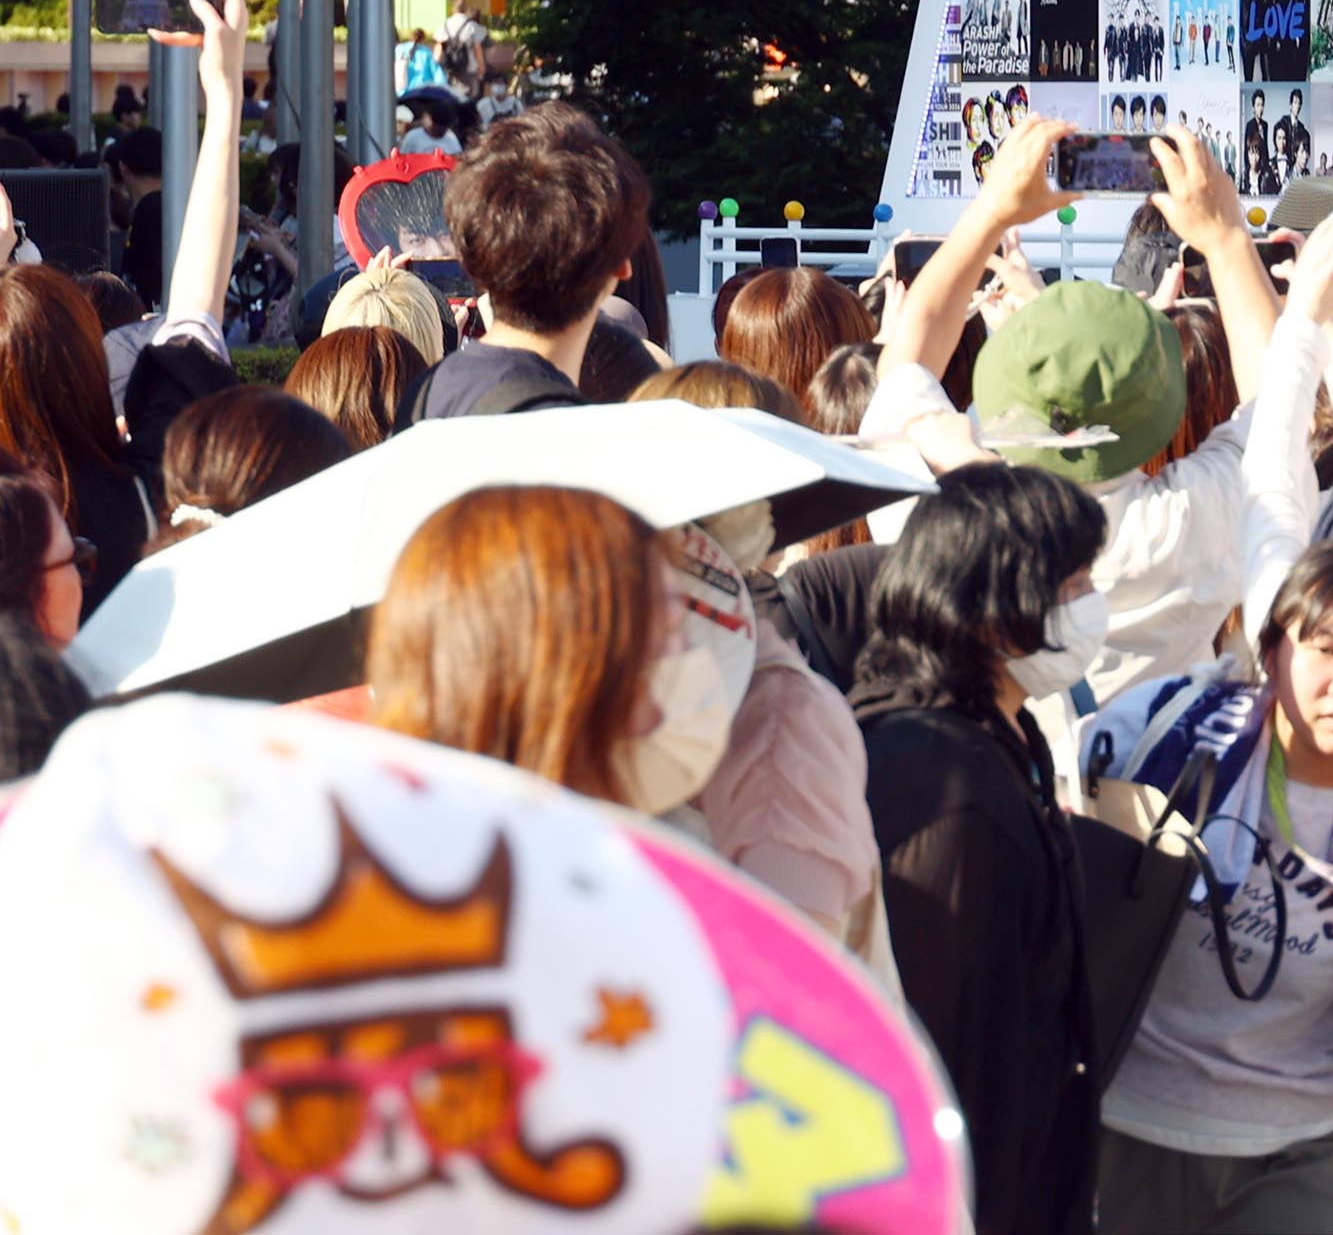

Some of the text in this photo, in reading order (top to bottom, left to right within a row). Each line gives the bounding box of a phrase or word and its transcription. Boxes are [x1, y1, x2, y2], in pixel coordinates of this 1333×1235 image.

[1247, 0, 1305, 42] LOVE
[963, 25, 1000, 39] ARASHI
[963, 40, 1011, 56] Power of
[963, 57, 1029, 74] the Paradise
